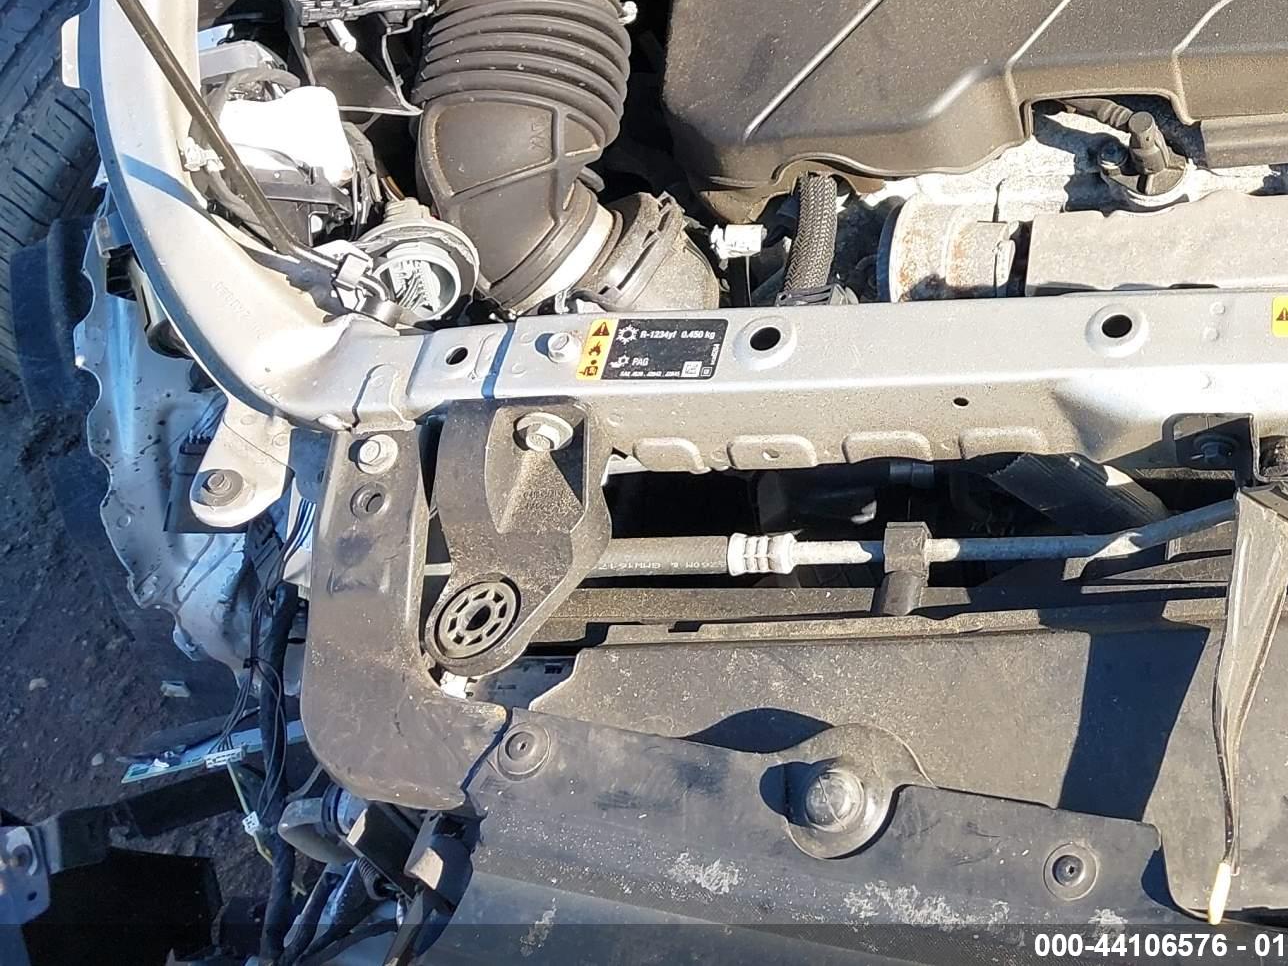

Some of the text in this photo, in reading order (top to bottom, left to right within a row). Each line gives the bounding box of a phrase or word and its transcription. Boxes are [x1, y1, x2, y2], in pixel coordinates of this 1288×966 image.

[639, 330, 716, 340] R-1234yf 0.450 kg
[632, 357, 649, 367] PAG
